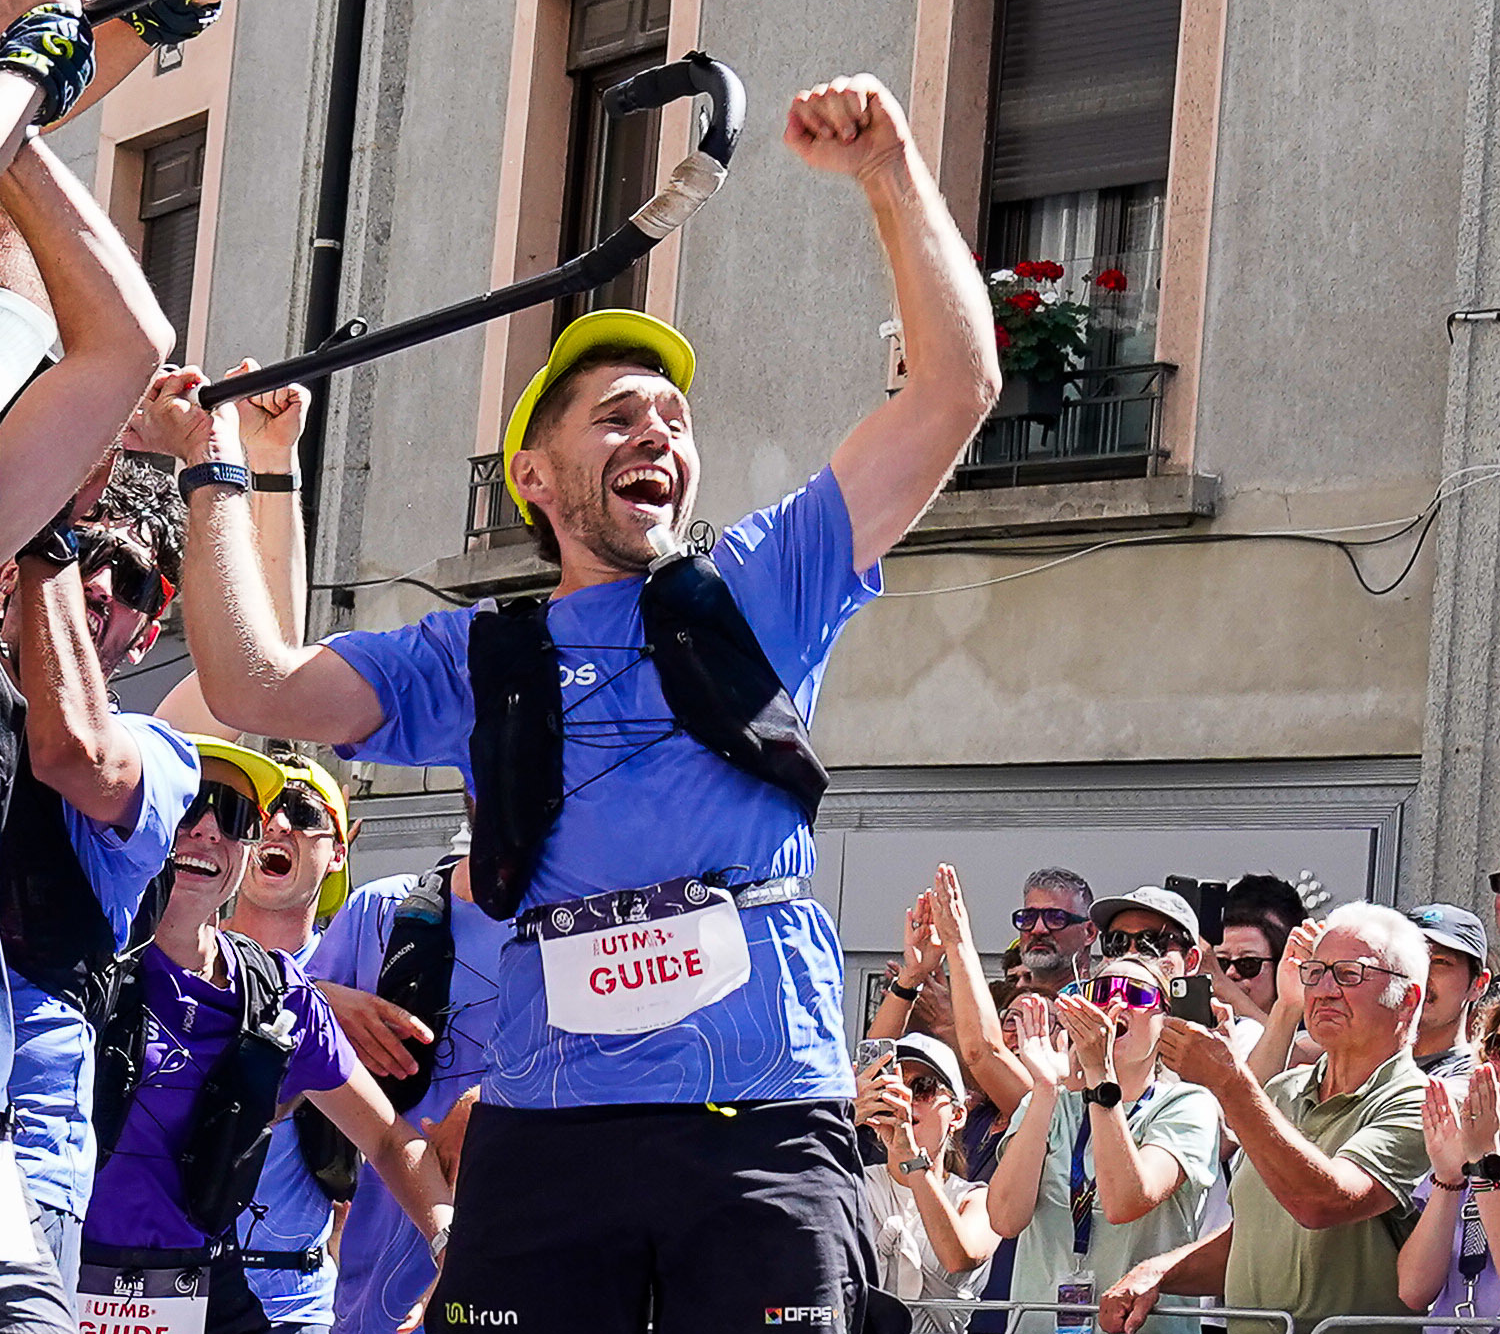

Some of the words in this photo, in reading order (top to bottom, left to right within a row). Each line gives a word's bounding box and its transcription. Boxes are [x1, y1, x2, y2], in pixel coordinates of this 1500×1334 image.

[588, 948, 704, 996] GUIDE
[93, 1301, 150, 1318] UTMB
[469, 1304, 519, 1326] i-run
[784, 1306, 833, 1323] OFPS
